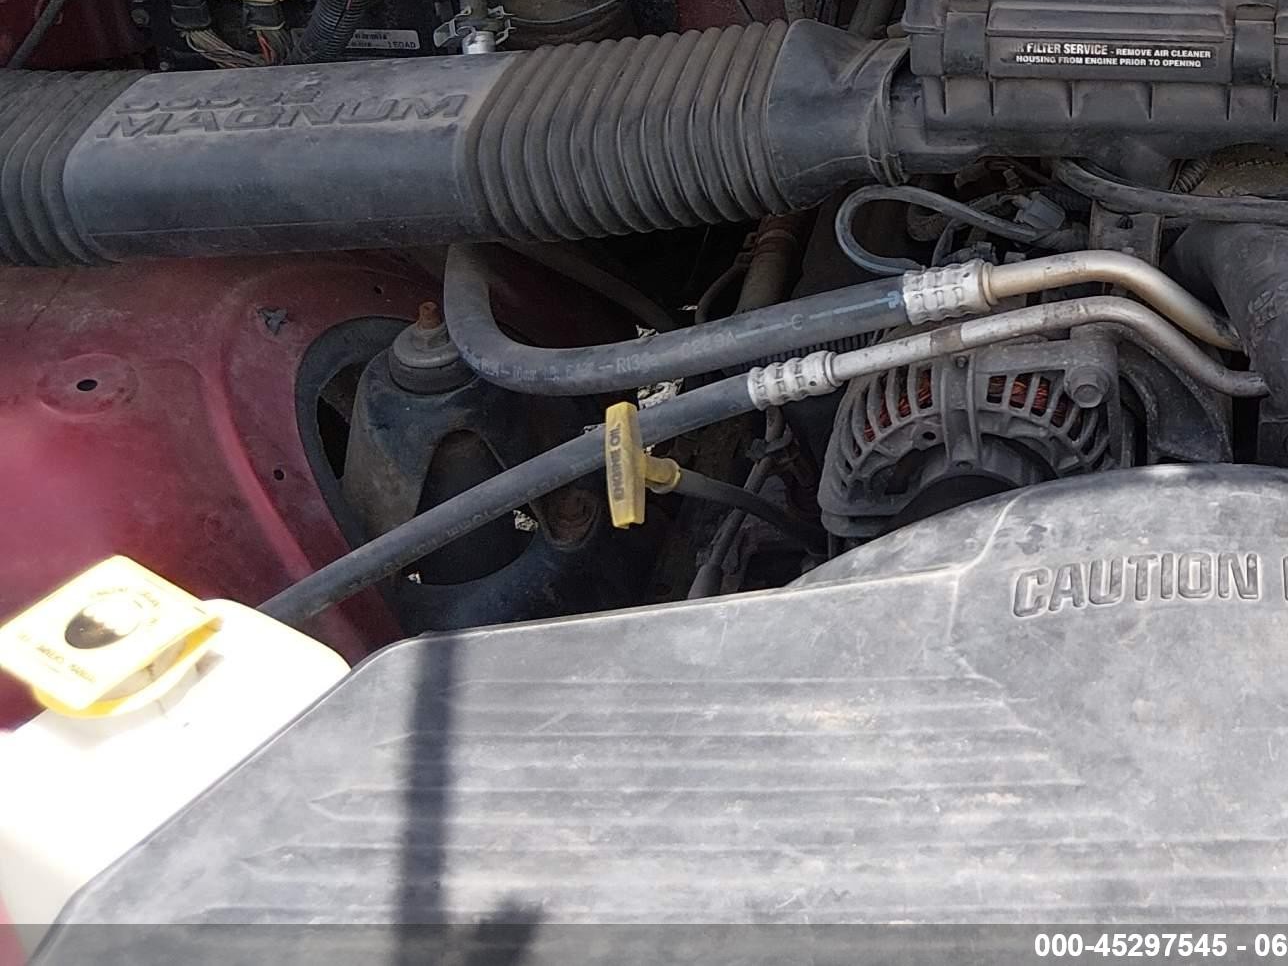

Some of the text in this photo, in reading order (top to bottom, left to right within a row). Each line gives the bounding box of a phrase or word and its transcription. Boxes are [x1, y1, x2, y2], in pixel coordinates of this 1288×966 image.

[1016, 55, 1057, 63] HOUSING
[1058, 56, 1083, 64] FROM
[1085, 57, 1118, 65] ENGINE
[1120, 58, 1147, 66] PRIOR
[1162, 59, 1202, 68] OPENING
[1026, 42, 1061, 54] FILTER
[1063, 43, 1109, 55] SERVICE
[1116, 48, 1152, 57] REMOVE
[1154, 49, 1169, 57] AIR
[1171, 50, 1211, 59] CLEANER
[96, 94, 468, 139] MAGNUM
[609, 423, 625, 502] ENGINE OIL
[1013, 551, 1261, 618] CAUTION
